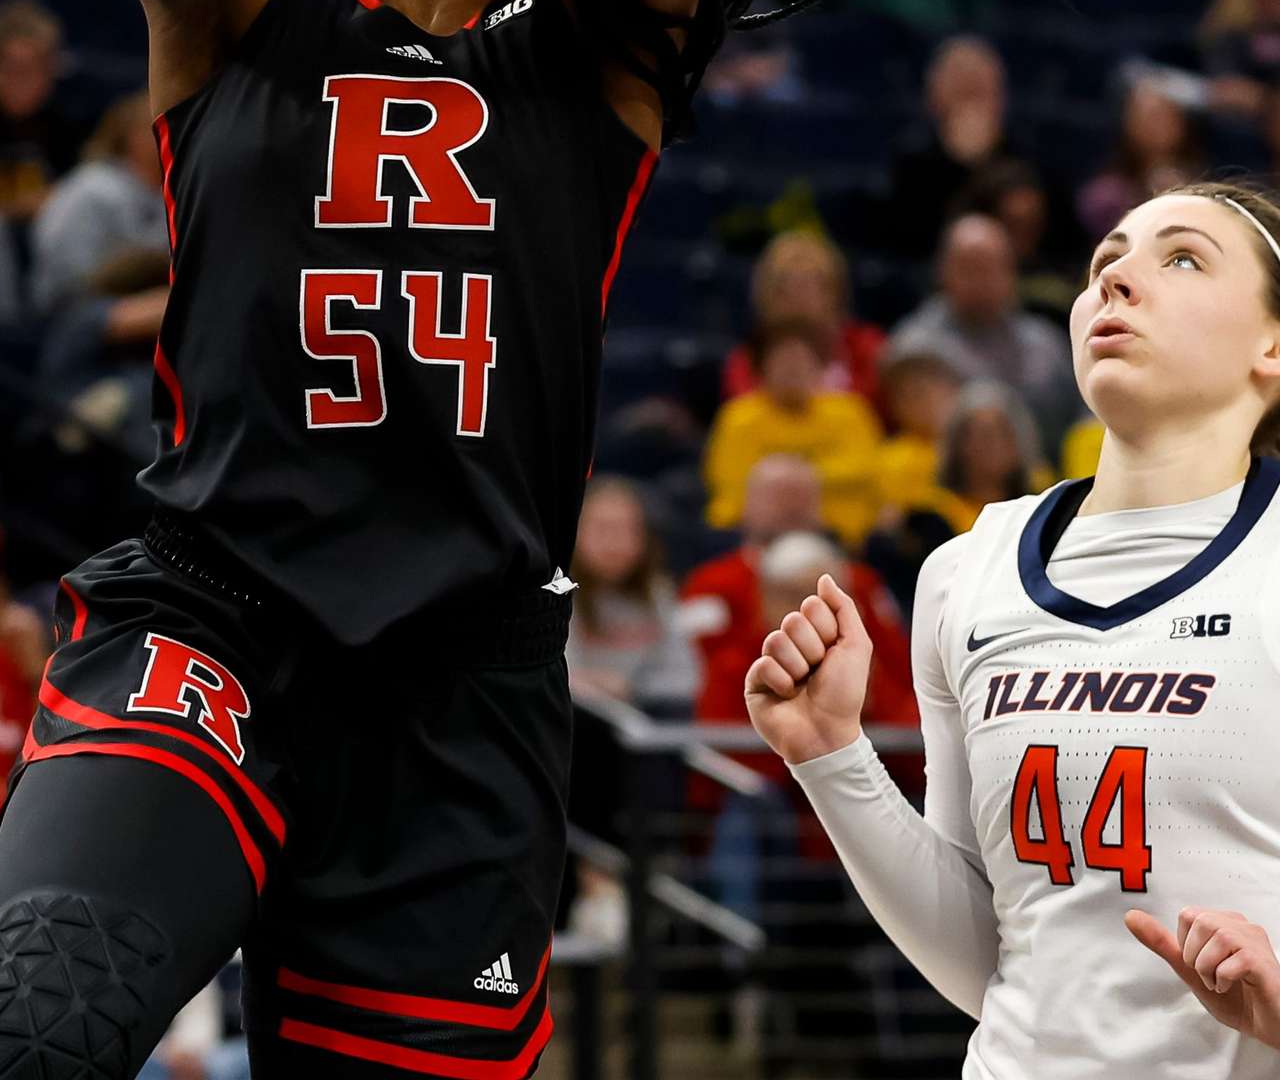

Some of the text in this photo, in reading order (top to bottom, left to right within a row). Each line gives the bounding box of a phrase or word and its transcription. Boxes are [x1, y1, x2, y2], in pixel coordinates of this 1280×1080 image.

[314, 73, 496, 231] R
[300, 269, 497, 437] 54
[126, 632, 251, 766] R
[982, 670, 1218, 721] ILLINOIS
[1010, 744, 1152, 893] 44
[473, 976, 519, 994] adidas
